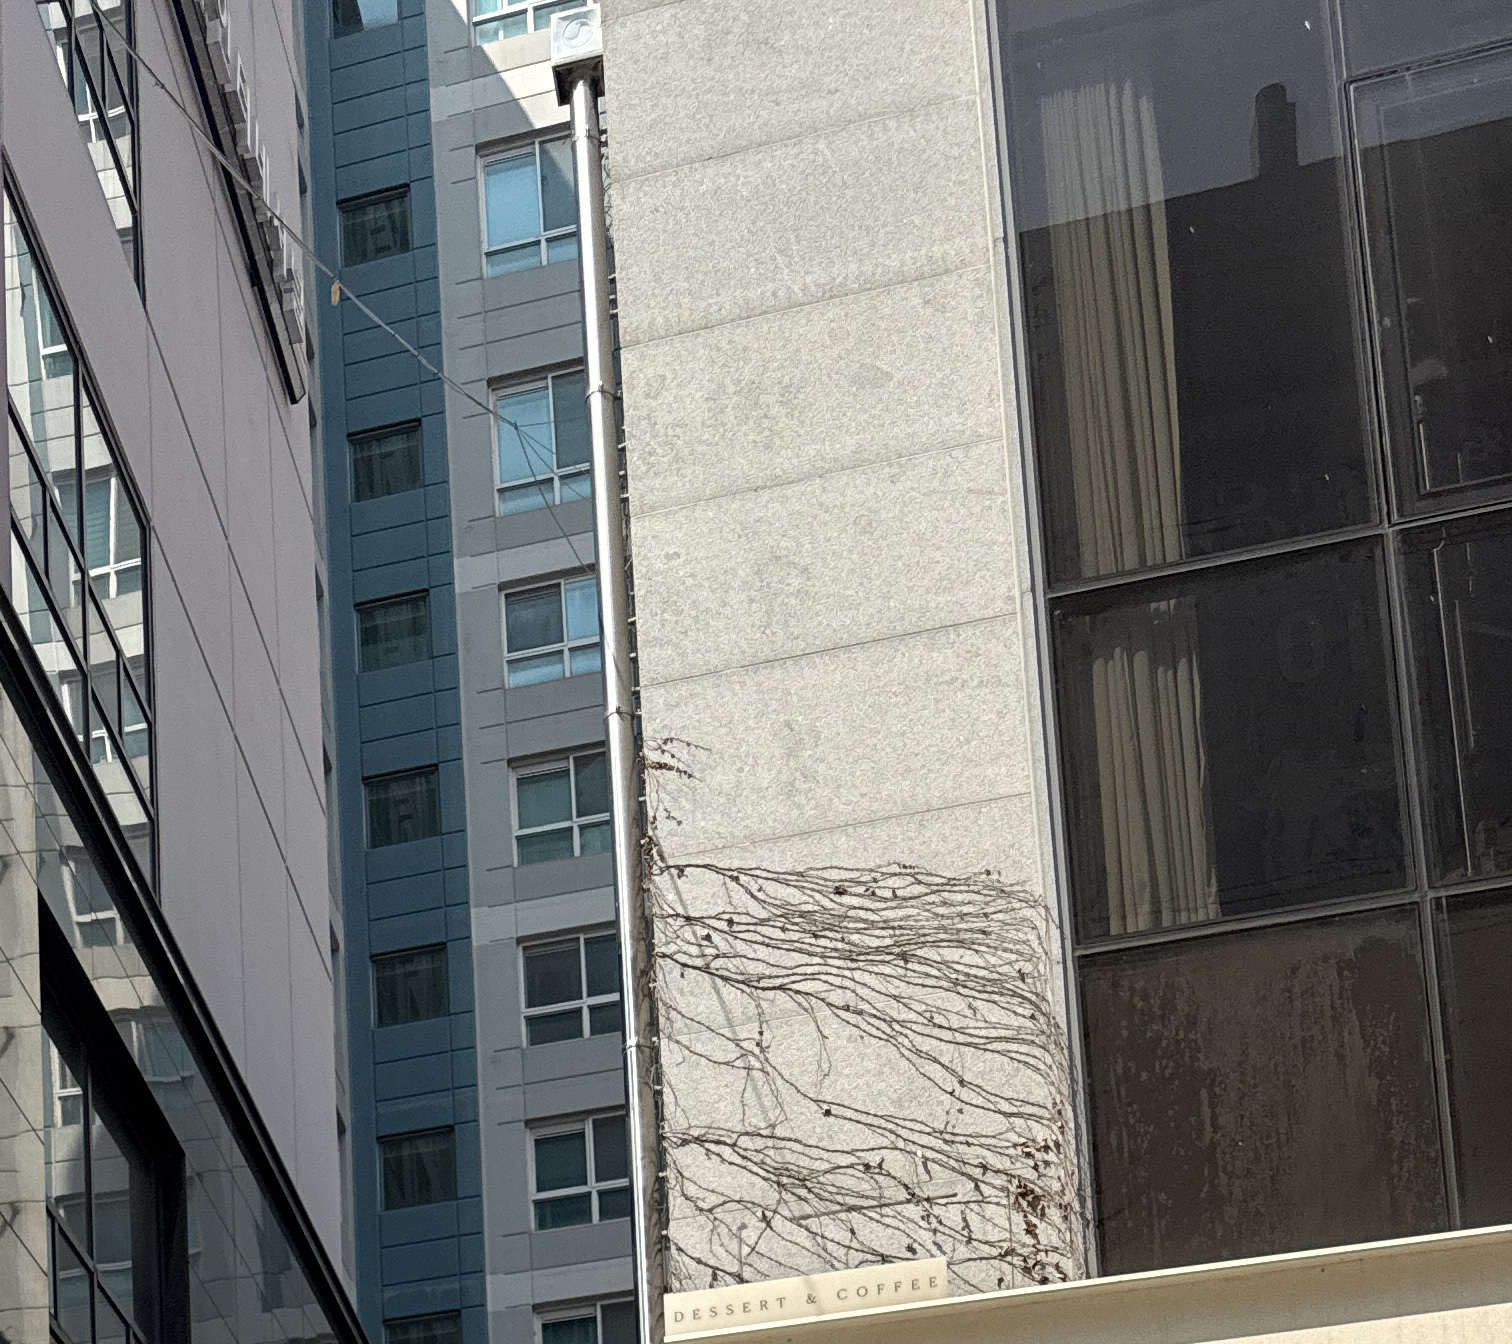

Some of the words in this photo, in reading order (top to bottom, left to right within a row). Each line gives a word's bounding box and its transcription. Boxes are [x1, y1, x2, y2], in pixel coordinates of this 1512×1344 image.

[674, 1296, 787, 1323] DESSERT
[805, 1293, 818, 1305] &
[836, 1276, 939, 1301] COFFEE
